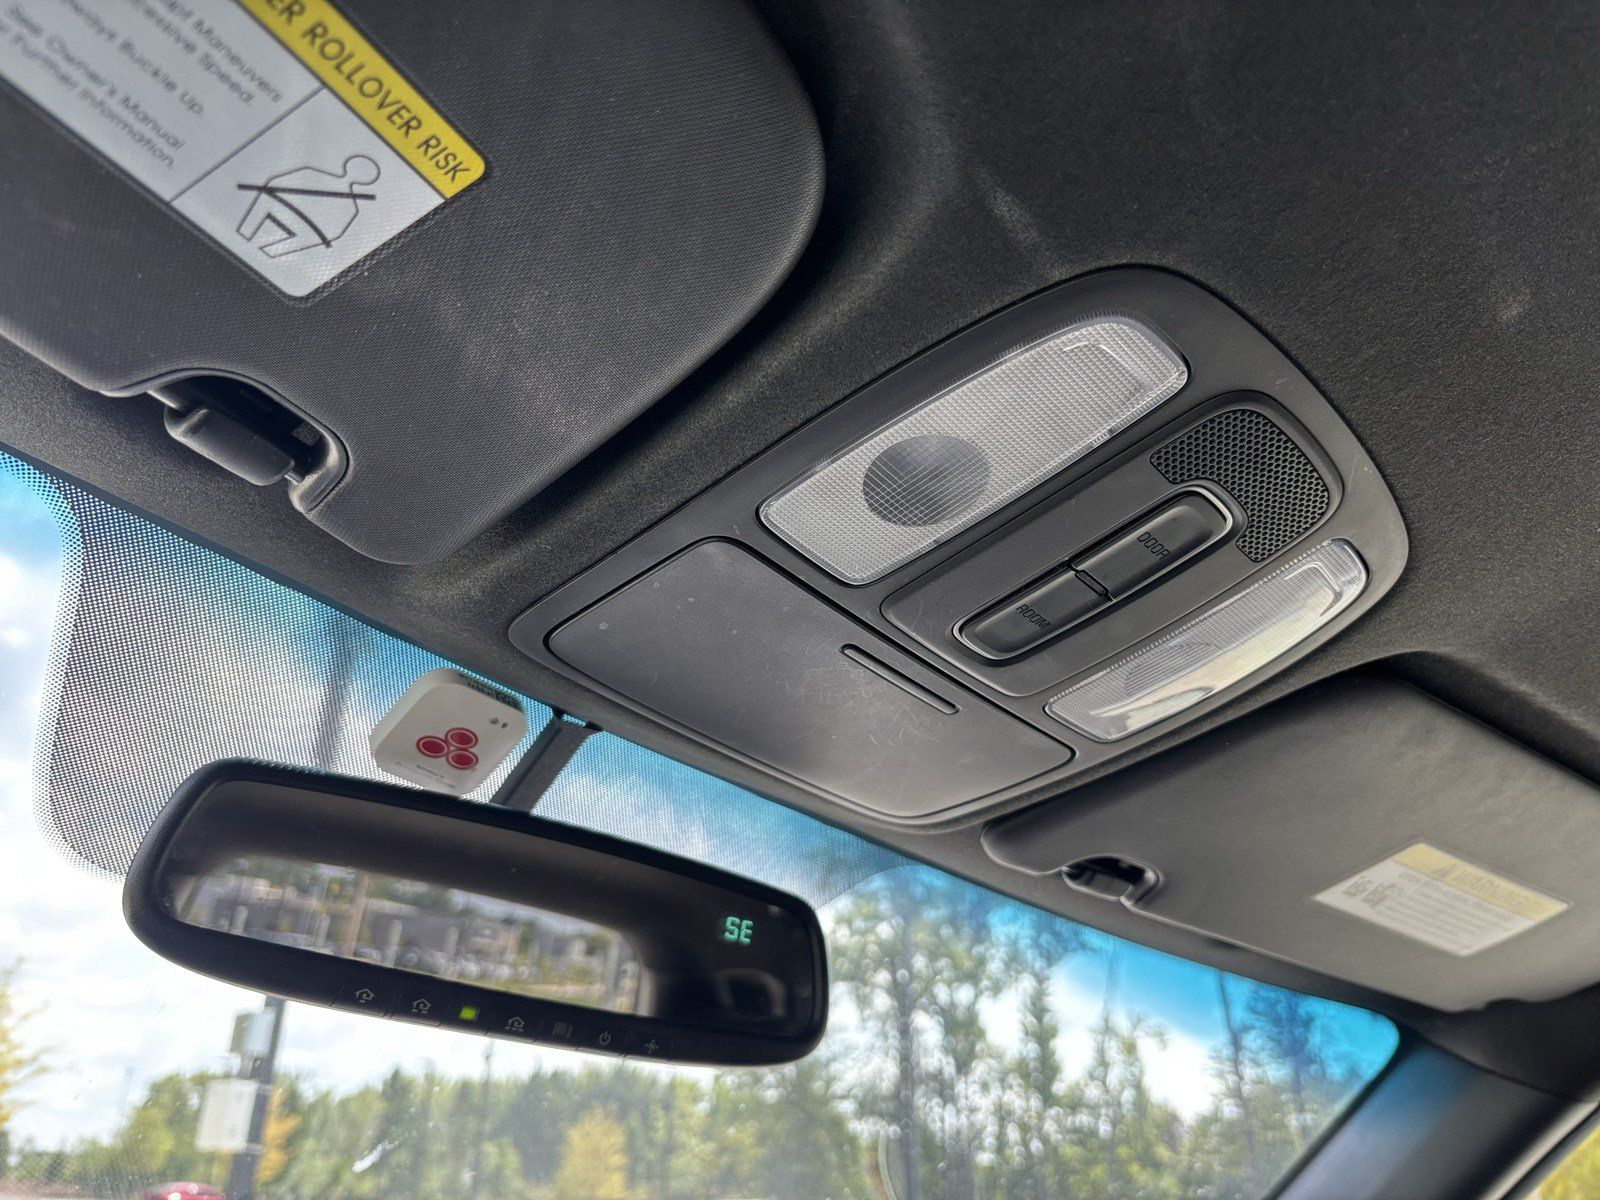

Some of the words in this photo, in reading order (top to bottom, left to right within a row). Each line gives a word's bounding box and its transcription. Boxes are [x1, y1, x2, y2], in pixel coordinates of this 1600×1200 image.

[118, 38, 179, 93] Buckle
[192, 18, 282, 102] Maneuvers
[119, 94, 187, 150] Manual
[302, 21, 423, 139] ROLLOVER
[417, 135, 470, 183] RISK
[1136, 531, 1170, 561] DOOR
[1015, 604, 1051, 640] ROOM
[724, 916, 754, 945] SE
